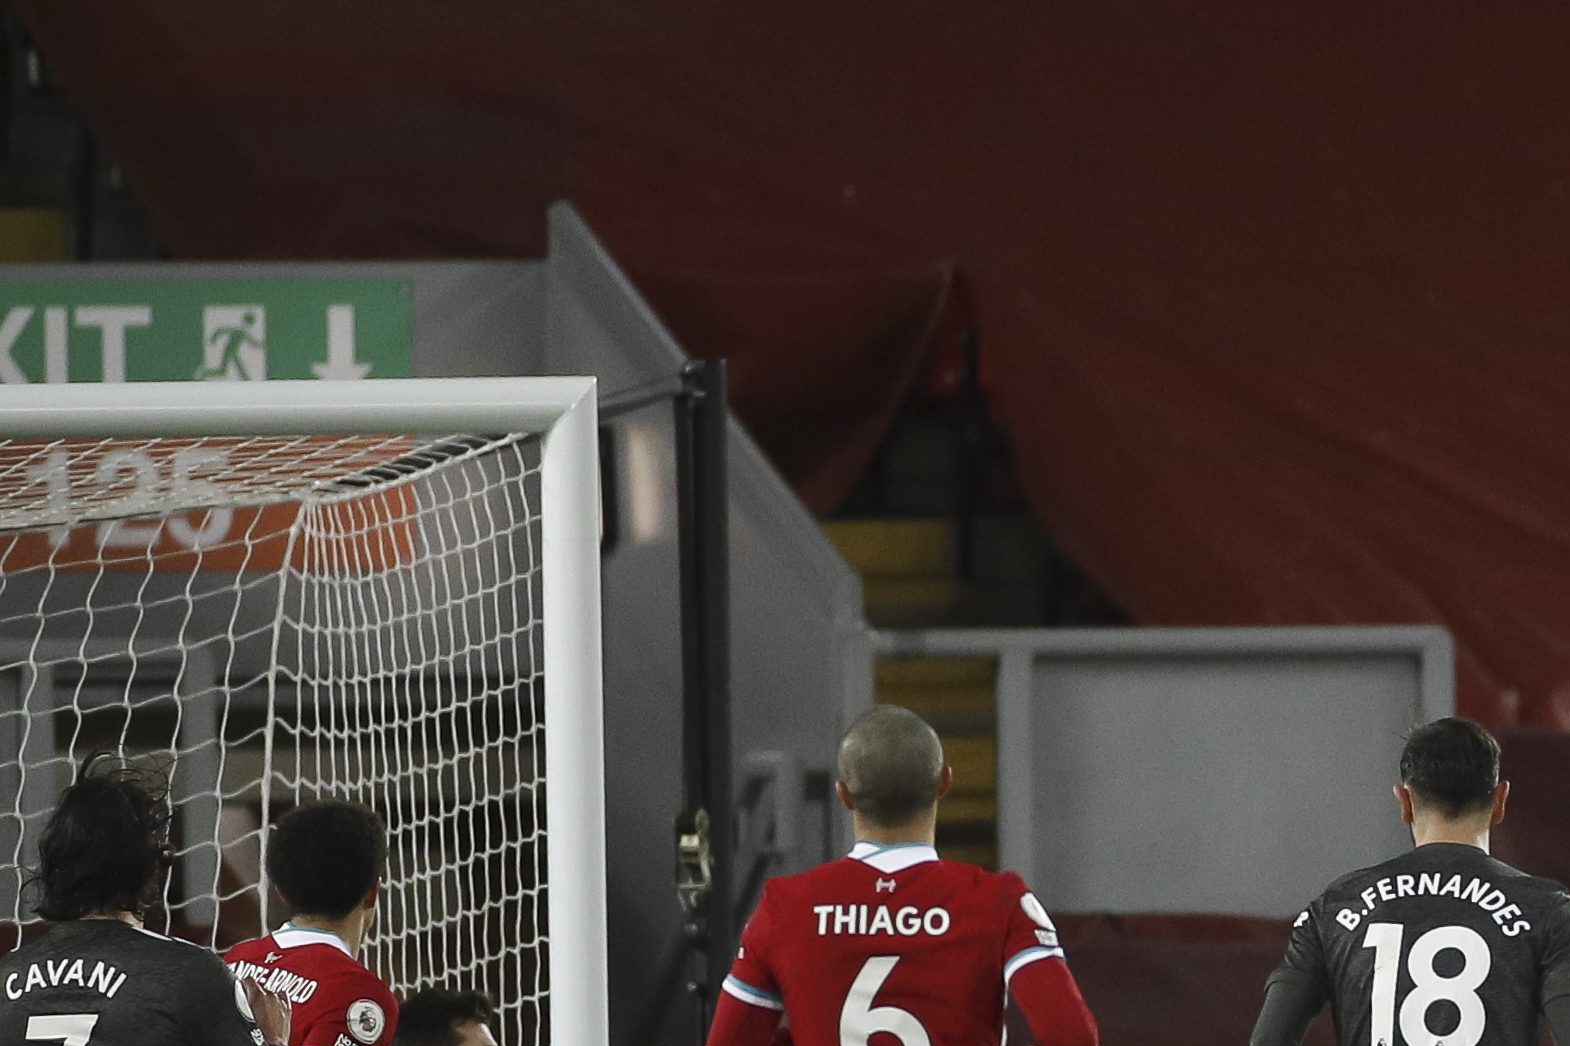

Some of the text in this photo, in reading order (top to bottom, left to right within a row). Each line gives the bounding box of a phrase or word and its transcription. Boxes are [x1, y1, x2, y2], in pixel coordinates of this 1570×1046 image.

[813, 904, 950, 936] THIAGO
[1335, 872, 1532, 937] B.FERNANDES
[6, 959, 127, 1000] CAVANI
